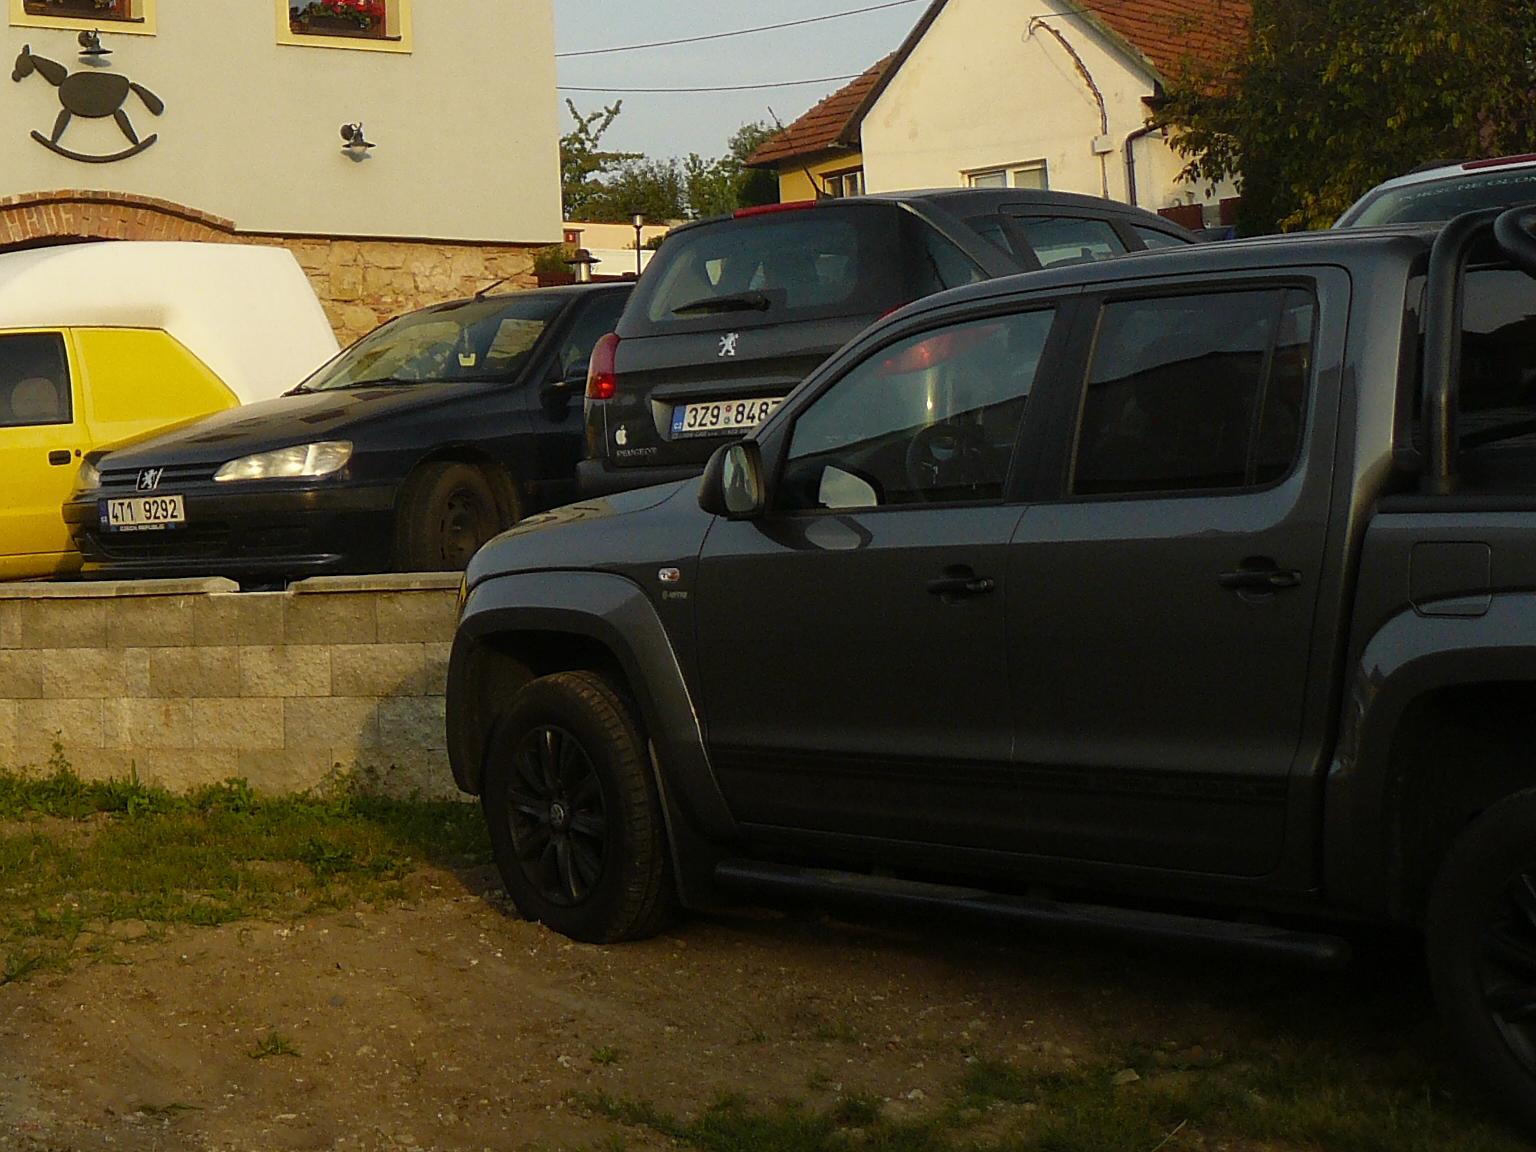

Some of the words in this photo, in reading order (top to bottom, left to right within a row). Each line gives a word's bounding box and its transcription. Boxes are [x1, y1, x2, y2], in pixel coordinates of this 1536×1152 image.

[687, 405, 721, 428] 3Z9
[112, 501, 134, 522] 4T1
[143, 499, 178, 520] 9292
